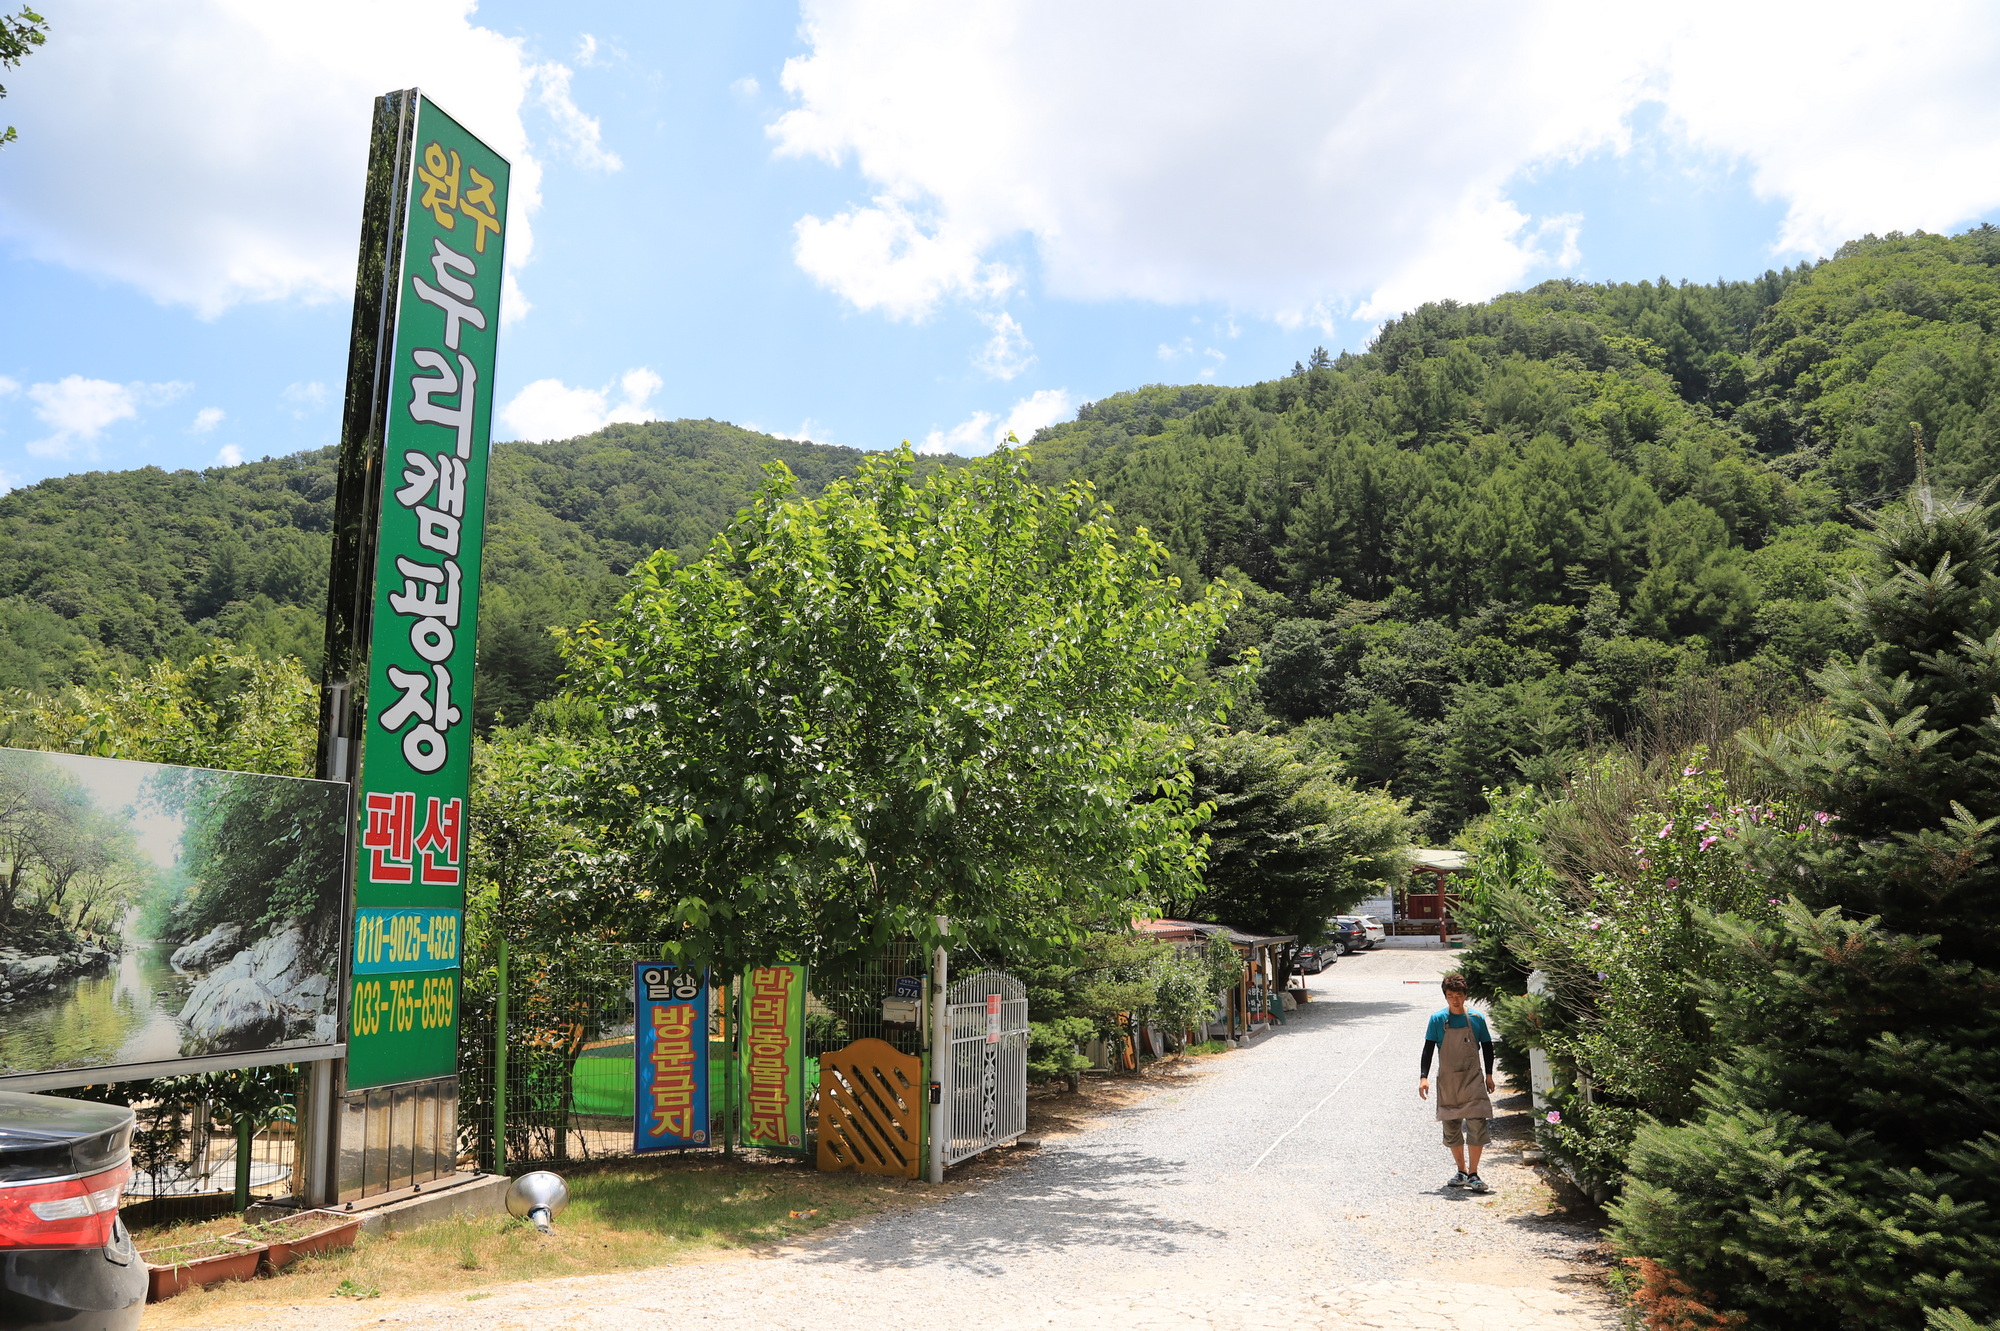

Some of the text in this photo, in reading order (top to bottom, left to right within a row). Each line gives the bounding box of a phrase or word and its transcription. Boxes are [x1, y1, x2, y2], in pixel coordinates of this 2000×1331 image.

[417, 141, 500, 253] 원주
[379, 236, 487, 775] 두리캠핑장
[363, 792, 462, 885] 펜션
[357, 915, 456, 964] 010-9025-4323
[353, 976, 454, 1037] 033-765-8569
[897, 987, 918, 998] 974
[650, 1004, 697, 1138] 방문금지
[749, 968, 793, 1144] 반려동물금지
